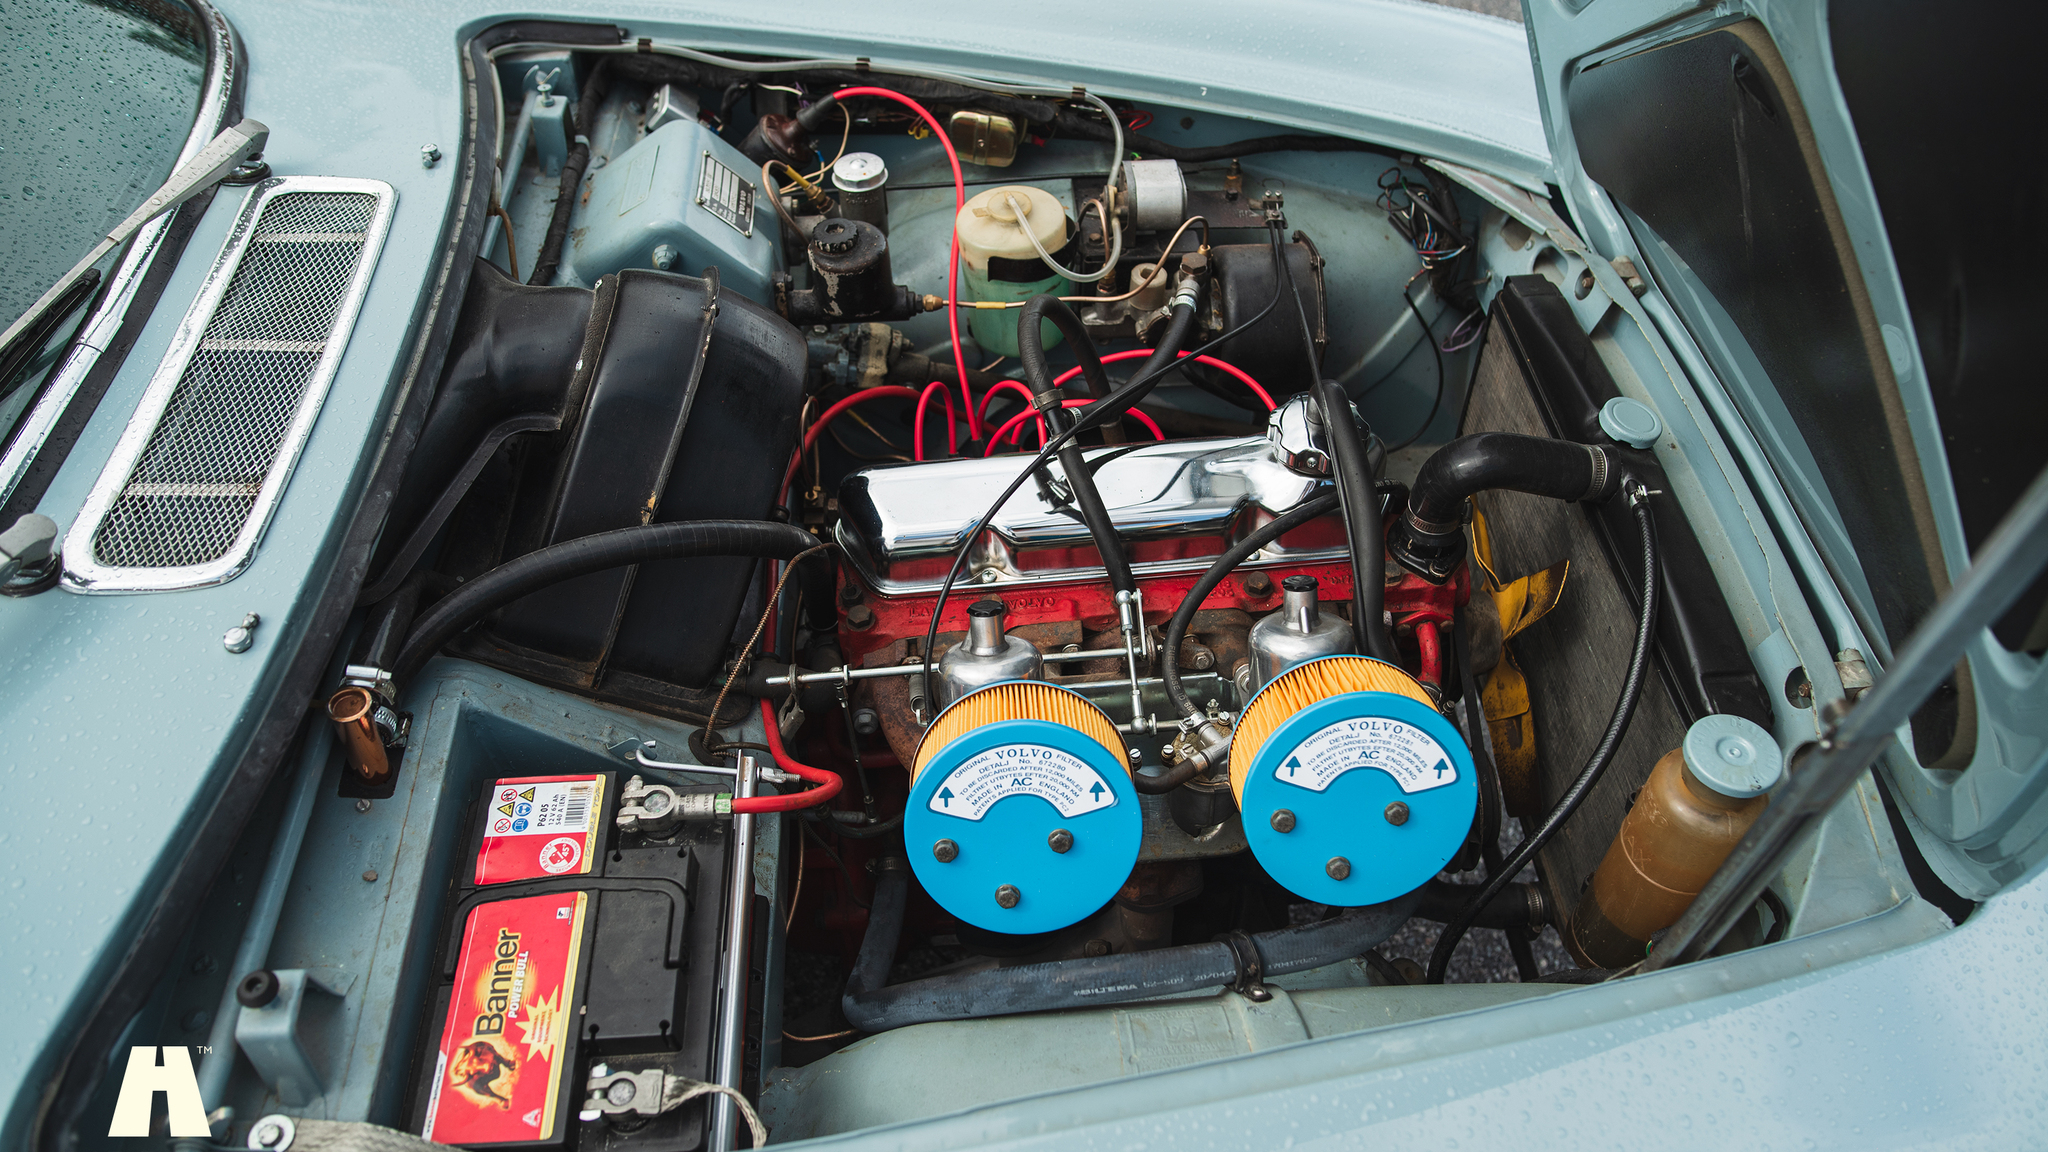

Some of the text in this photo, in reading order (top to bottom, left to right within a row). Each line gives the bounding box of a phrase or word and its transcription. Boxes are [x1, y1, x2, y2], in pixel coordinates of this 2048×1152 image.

[1006, 596, 1056, 610] VOLVO
[1167, 645, 1176, 666] FUEL
[1168, 669, 1181, 691] HOSE
[1176, 692, 1186, 701] ID
[1305, 721, 1431, 748] ORIGINAL VOLVO FILTER
[1329, 732, 1360, 745] DETALJ
[954, 748, 1083, 779] ORIGINAL VOLVO FILTER
[979, 760, 1009, 774] DETALJ
[1038, 759, 1066, 772] 672280
[1312, 753, 1337, 772] FILTRET
[1338, 745, 1372, 757] UTBYTES
[1373, 745, 1396, 755] EFTER
[1414, 763, 1424, 774] KM
[1316, 751, 1325, 759] BE
[1325, 738, 1368, 753] DISCARDED
[1369, 738, 1392, 746] AFTER
[1412, 752, 1428, 769] MILES
[1317, 760, 1340, 778] MADE
[1358, 750, 1380, 760] AC
[1385, 755, 1418, 781] ENGLAND
[966, 780, 990, 802] FILTRET
[990, 772, 1023, 784] UTBYTES
[1025, 772, 1048, 780] EFTER
[1070, 787, 1080, 798] KM
[968, 781, 977, 789] BE
[978, 766, 1018, 782] DISCARDED
[1066, 776, 1084, 793] MILES
[1317, 765, 1343, 787] PATENTS
[1344, 760, 1373, 769] APPLIED
[1374, 760, 1389, 768] FOR
[1389, 765, 1403, 778] TYPE
[552, 793, 560, 803] Ah
[971, 777, 1075, 806] MADE IN AC ENGLAND
[974, 794, 997, 817] PATENTS
[998, 786, 1027, 796] APPLIED
[1044, 790, 1060, 803] TYPE
[537, 803, 549, 827] P62 05
[555, 813, 563, 826] 540
[584, 786, 601, 858] DOUBLE TOP
[475, 929, 520, 1036] Banner
[507, 950, 530, 1019] POWER BULL
